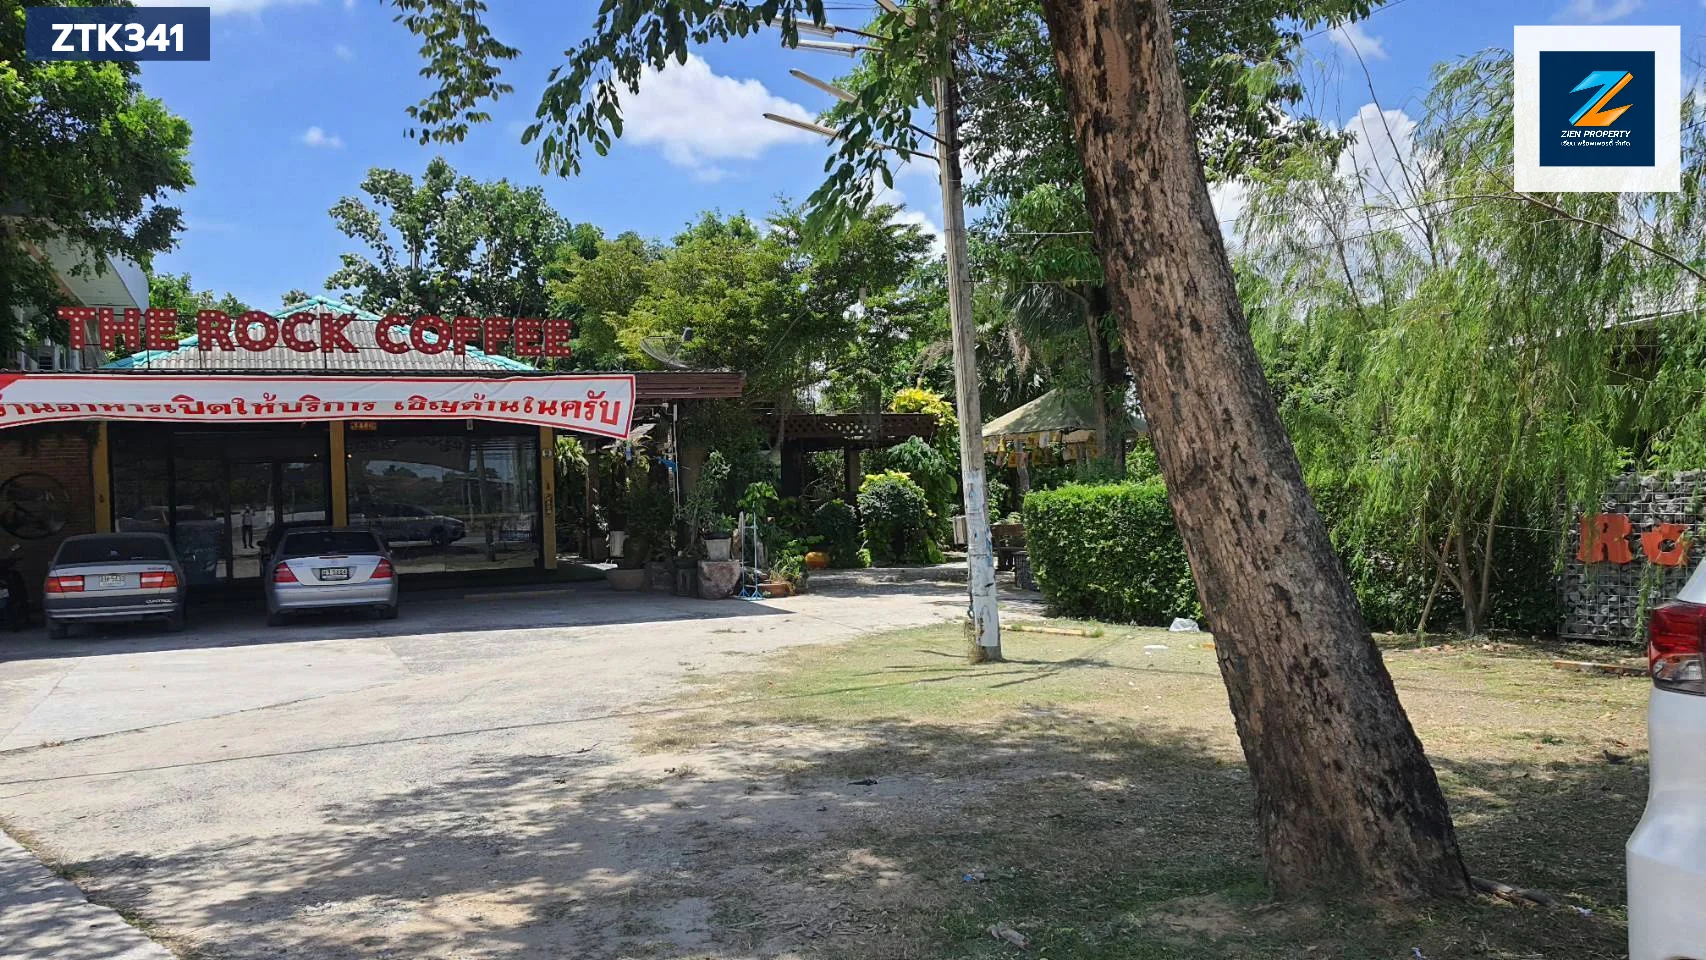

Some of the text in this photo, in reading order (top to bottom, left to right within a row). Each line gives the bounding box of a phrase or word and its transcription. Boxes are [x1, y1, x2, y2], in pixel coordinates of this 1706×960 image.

[57, 306, 576, 358] THE ROCK COFFEE
[0, 390, 622, 426] านอาหารเปิดให้บริการ เชิญด้านในครับ
